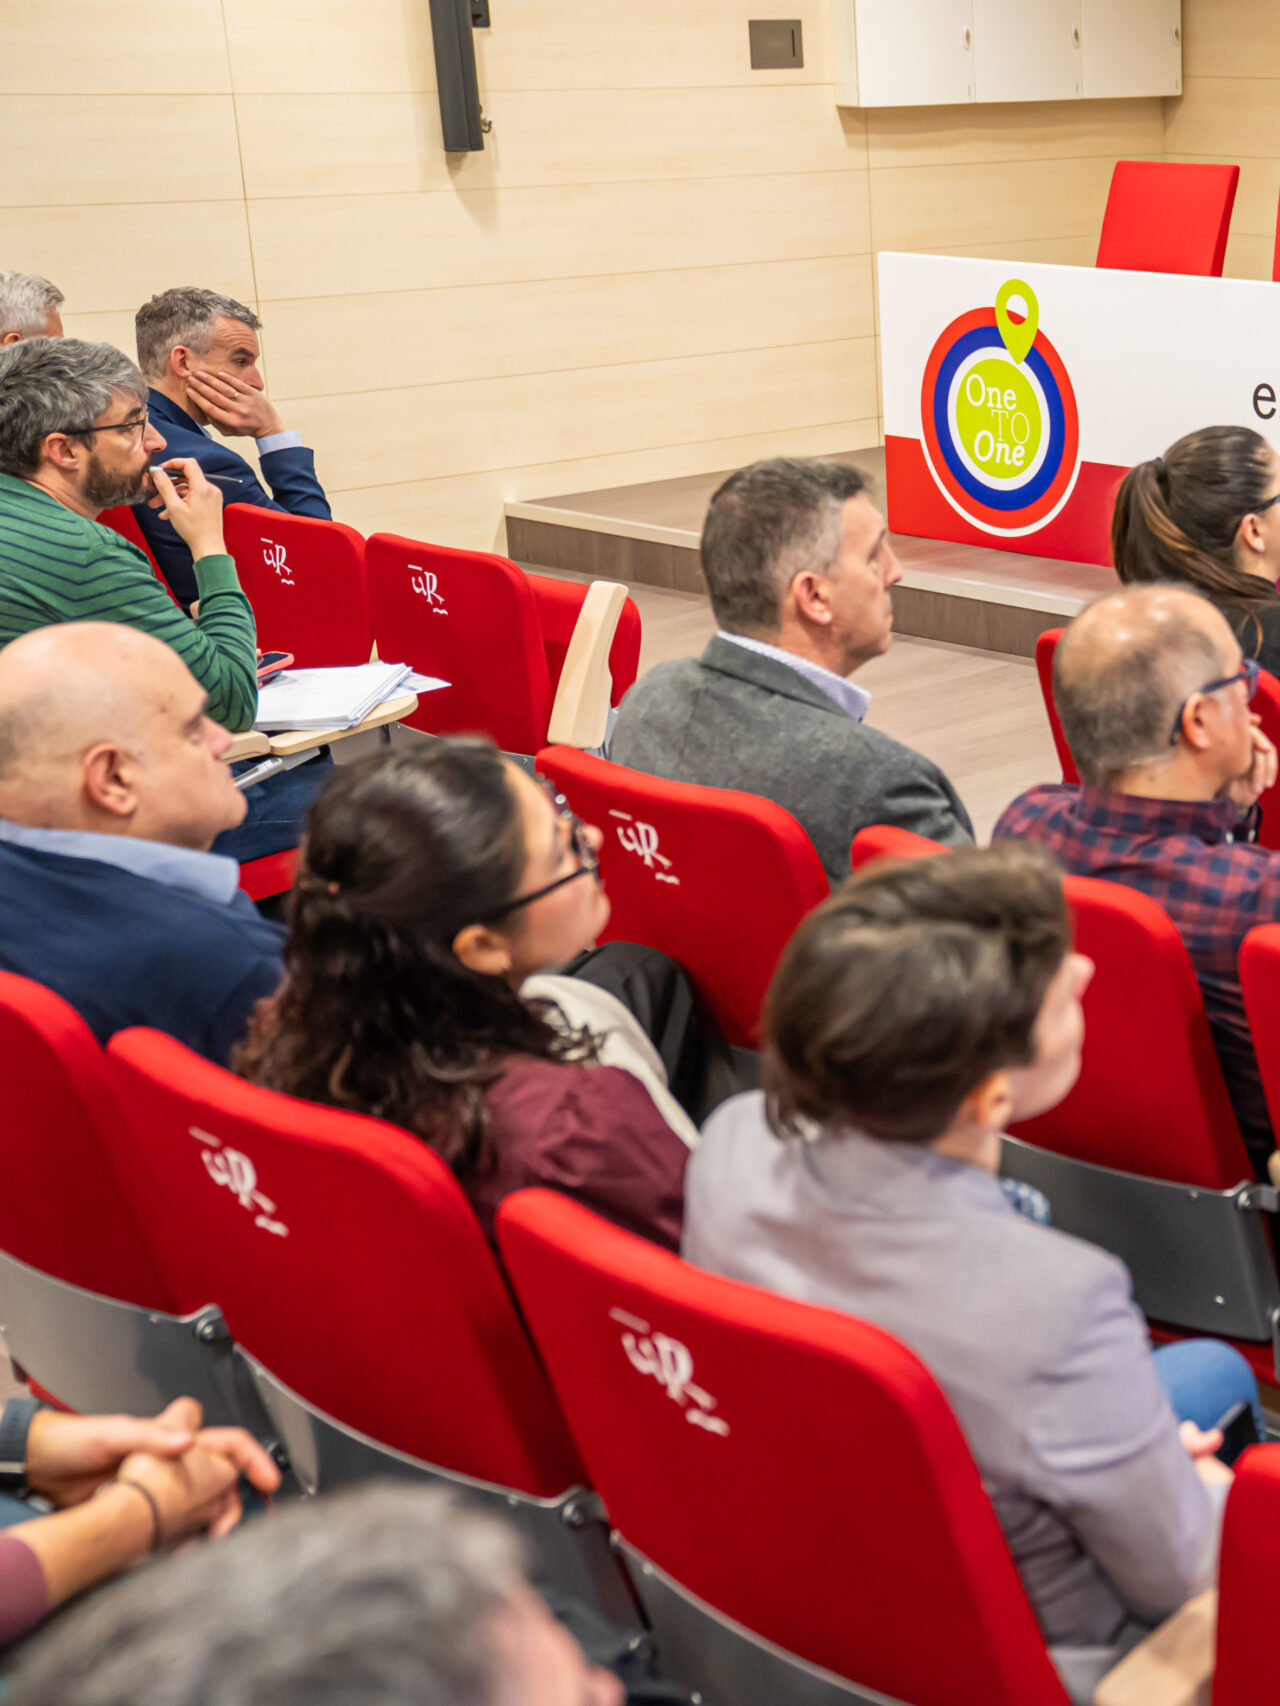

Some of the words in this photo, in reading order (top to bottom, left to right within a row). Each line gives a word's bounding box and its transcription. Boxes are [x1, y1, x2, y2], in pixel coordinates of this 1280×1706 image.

[966, 374, 1017, 411] One
[991, 409, 1030, 445] TO
[974, 430, 1026, 467] One
